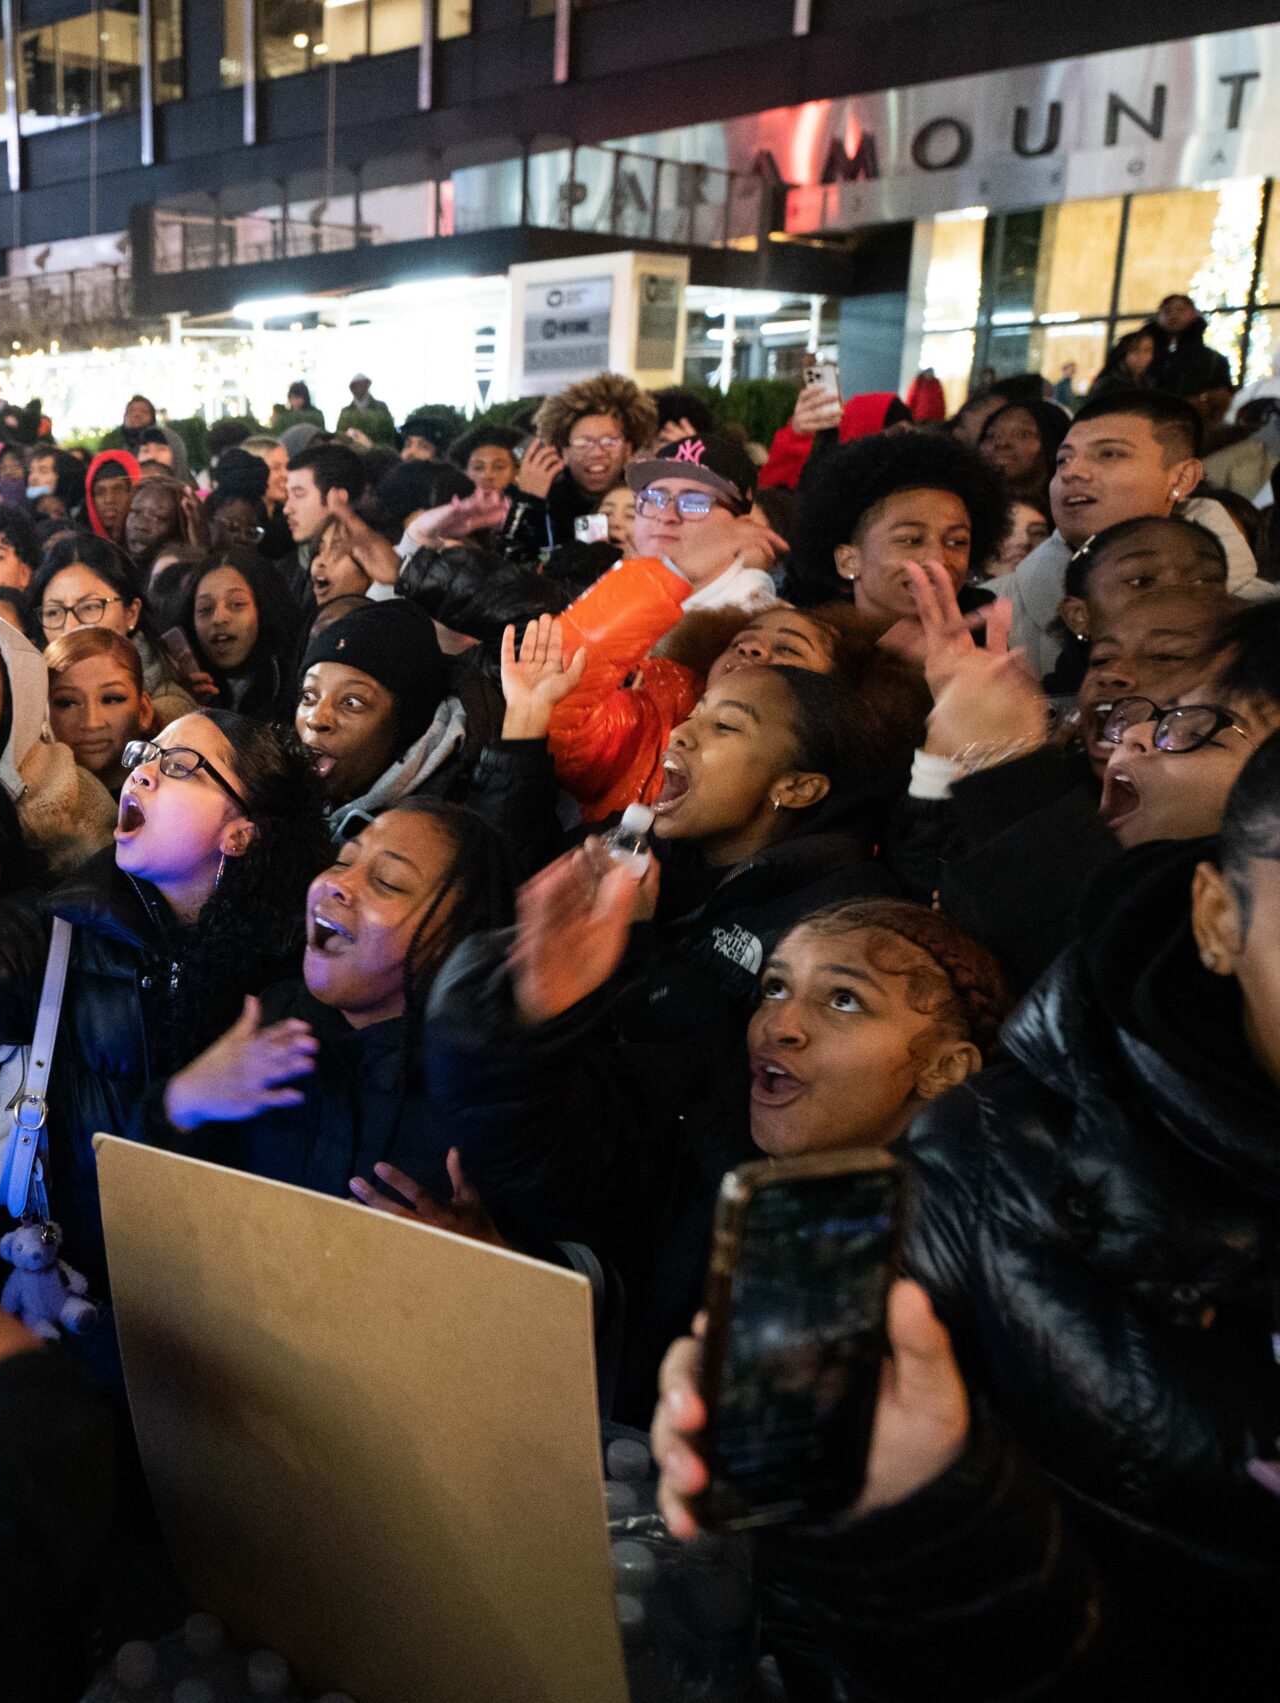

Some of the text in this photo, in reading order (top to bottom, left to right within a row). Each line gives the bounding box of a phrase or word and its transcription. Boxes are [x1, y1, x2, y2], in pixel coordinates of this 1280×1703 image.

[558, 70, 1261, 224] PARAMOUNT
[674, 438, 706, 465] NY
[731, 923, 754, 944] THE
[713, 941, 741, 963] FACE
